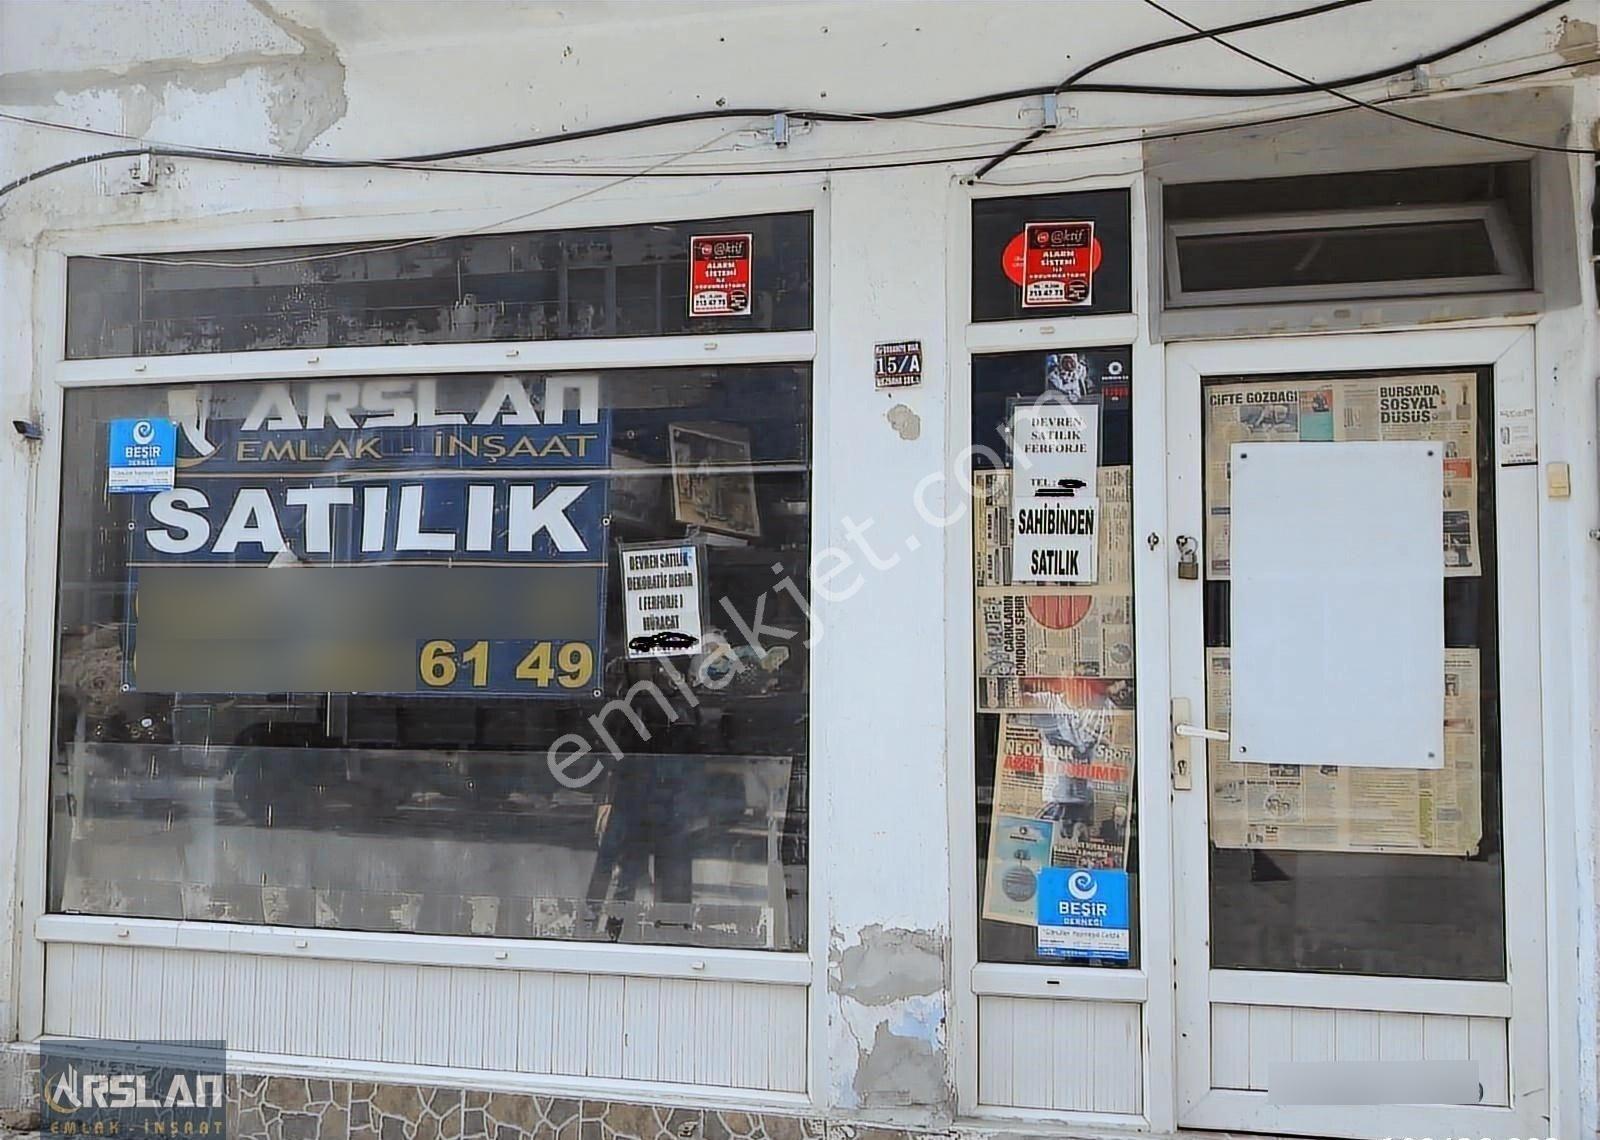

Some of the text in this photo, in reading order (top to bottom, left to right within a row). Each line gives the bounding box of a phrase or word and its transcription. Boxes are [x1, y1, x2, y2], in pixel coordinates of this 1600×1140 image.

[876, 354, 920, 374] 15/A
[1379, 385, 1440, 398] BURSA'DA
[1380, 397, 1438, 410] SOSYAL
[1031, 417, 1082, 427] DEVREN
[1031, 430, 1081, 440] SATILIK
[236, 437, 383, 462] EMLAK
[434, 431, 599, 463] İNŞAAT
[1024, 443, 1088, 453] FERFORJE
[145, 485, 590, 553] SATILIK
[1018, 502, 1094, 535] SAHİBİNDEN
[629, 551, 689, 571] DEVREN SATILIK
[1030, 549, 1079, 575] SATILIK
[626, 570, 694, 591] DEKORATİF DEMİR
[643, 594, 679, 611] FERFORJE
[418, 640, 594, 689] 61 49
[1059, 901, 1107, 917] BEŞİR
